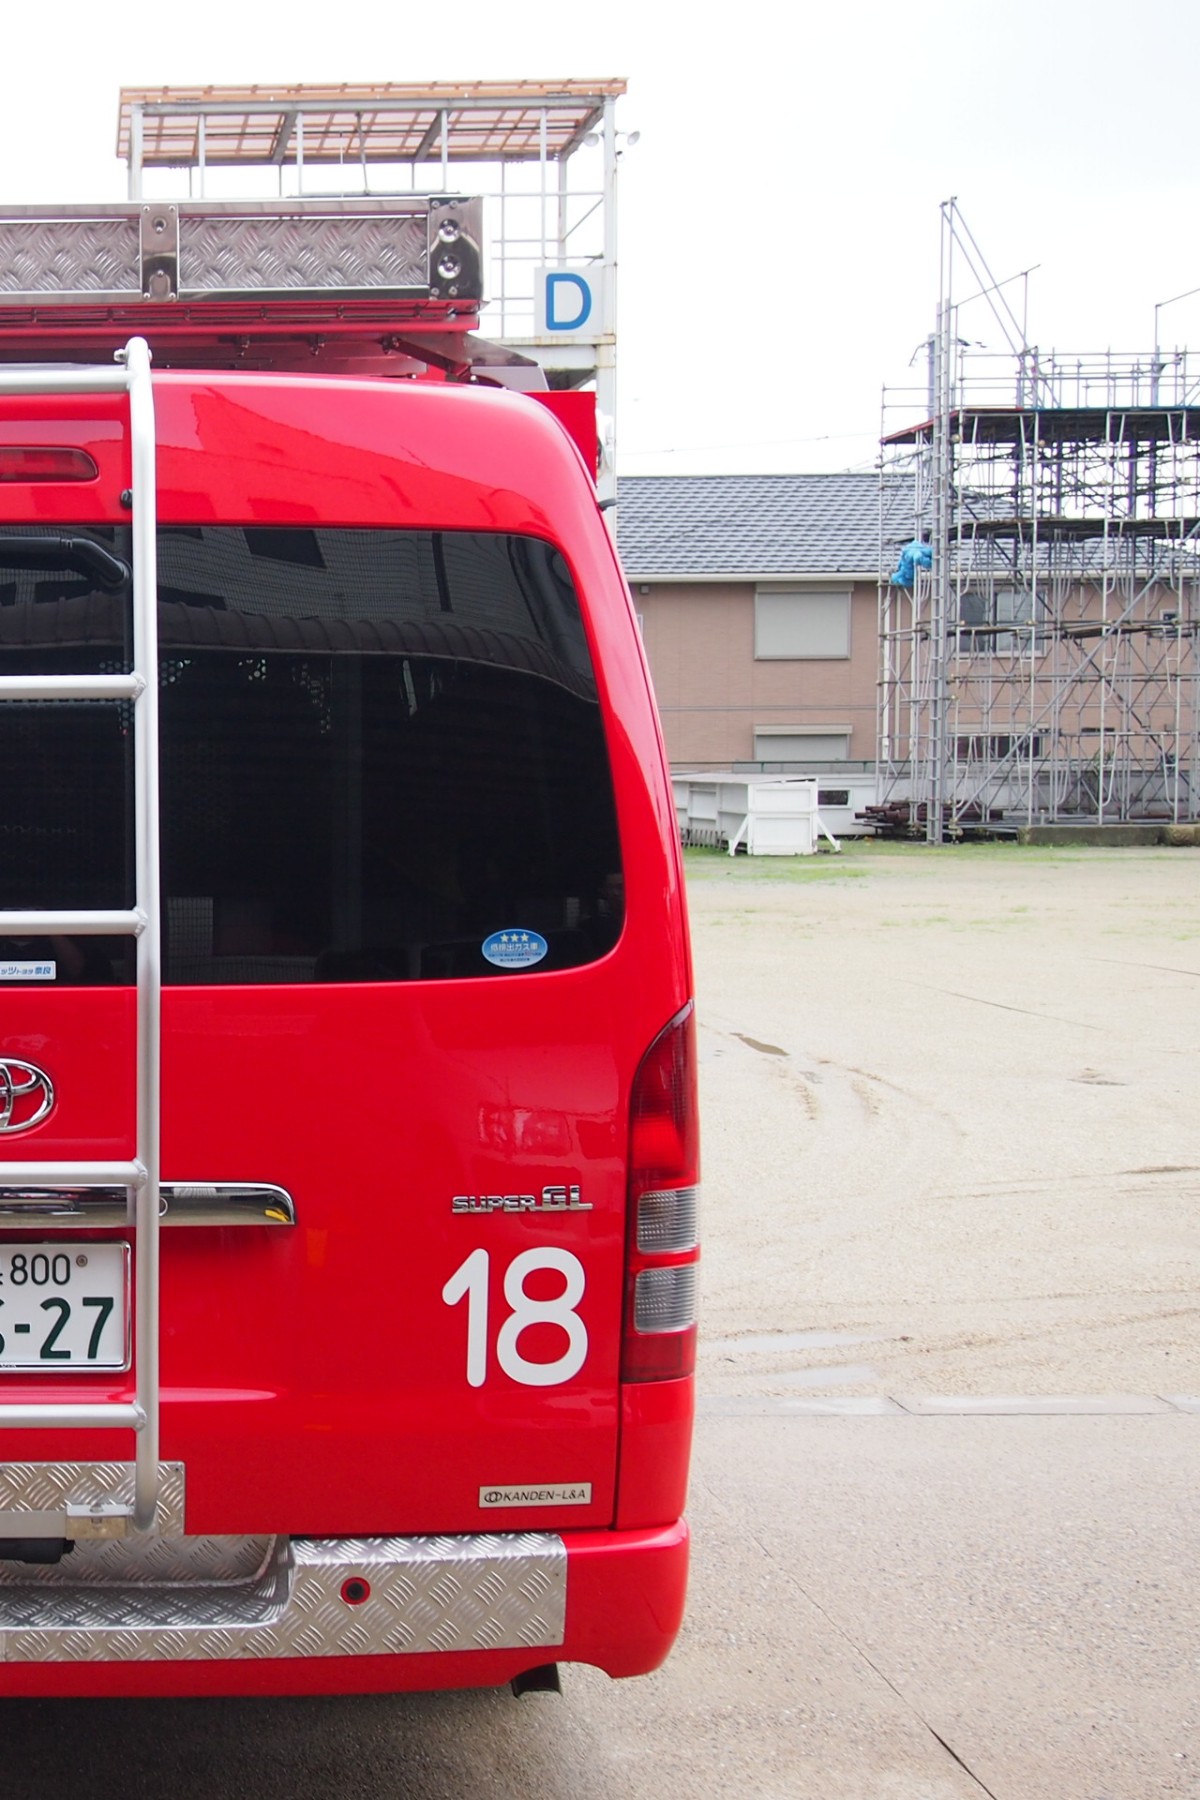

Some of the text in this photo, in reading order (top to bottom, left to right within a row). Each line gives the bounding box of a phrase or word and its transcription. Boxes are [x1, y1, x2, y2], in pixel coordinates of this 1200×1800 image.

[545, 273, 592, 331] D
[442, 1246, 588, 1388] 18
[503, 1488, 586, 1502] KANDEN-L&A
